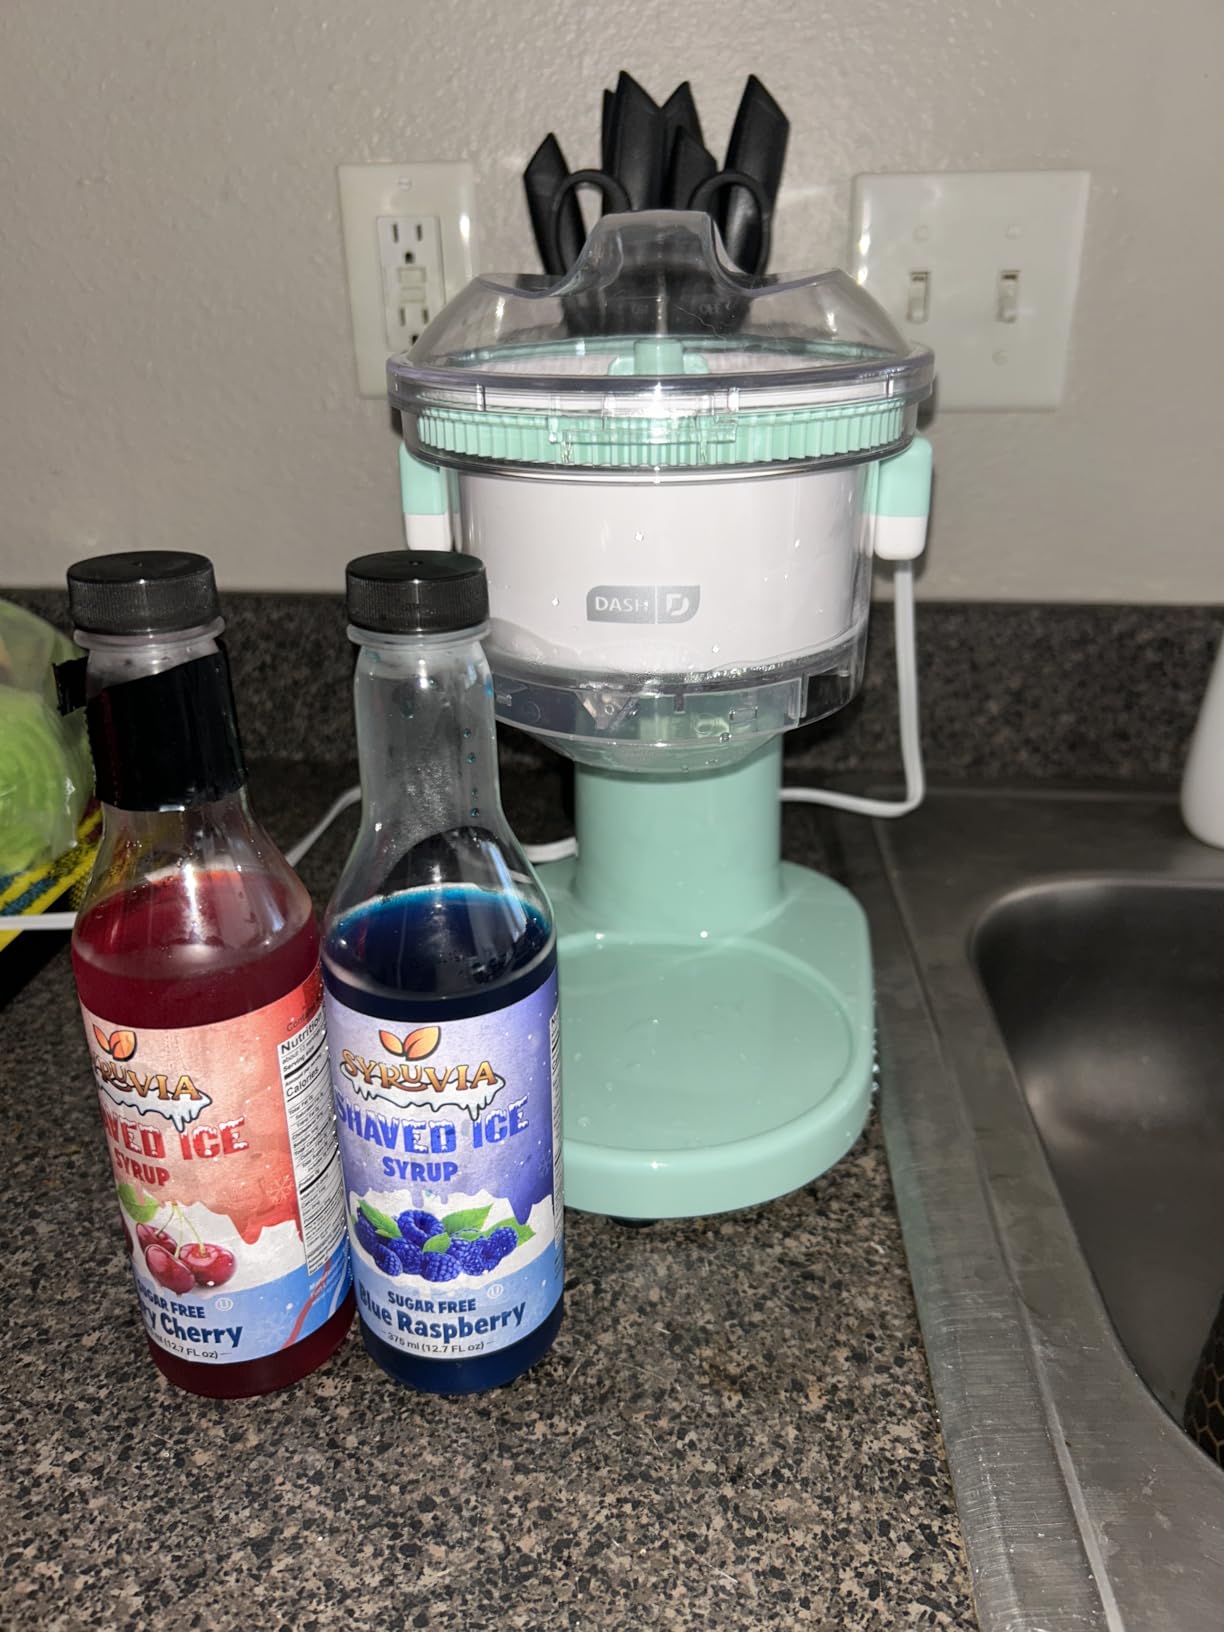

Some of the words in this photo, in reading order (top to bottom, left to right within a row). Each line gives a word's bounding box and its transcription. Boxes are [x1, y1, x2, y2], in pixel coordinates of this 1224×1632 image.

[96, 1057, 203, 1101] RUVIA
[286, 1066, 320, 1097] Calories
[342, 1049, 498, 1093] SYRUVIA
[179, 1116, 250, 1160] ICE
[335, 1091, 457, 1154] SHAVED
[471, 1096, 529, 1149] ICE
[114, 1148, 170, 1187] SYRUP
[382, 1156, 458, 1182] SYRUP
[170, 1301, 206, 1319] FREE
[358, 1280, 393, 1327] Blue
[397, 1301, 527, 1345] Raspberry
[387, 1290, 434, 1314] SUGAR
[438, 1298, 477, 1314] FREE
[160, 1312, 243, 1348] Cherry
[388, 1331, 406, 1347] 375
[407, 1341, 420, 1351] ml
